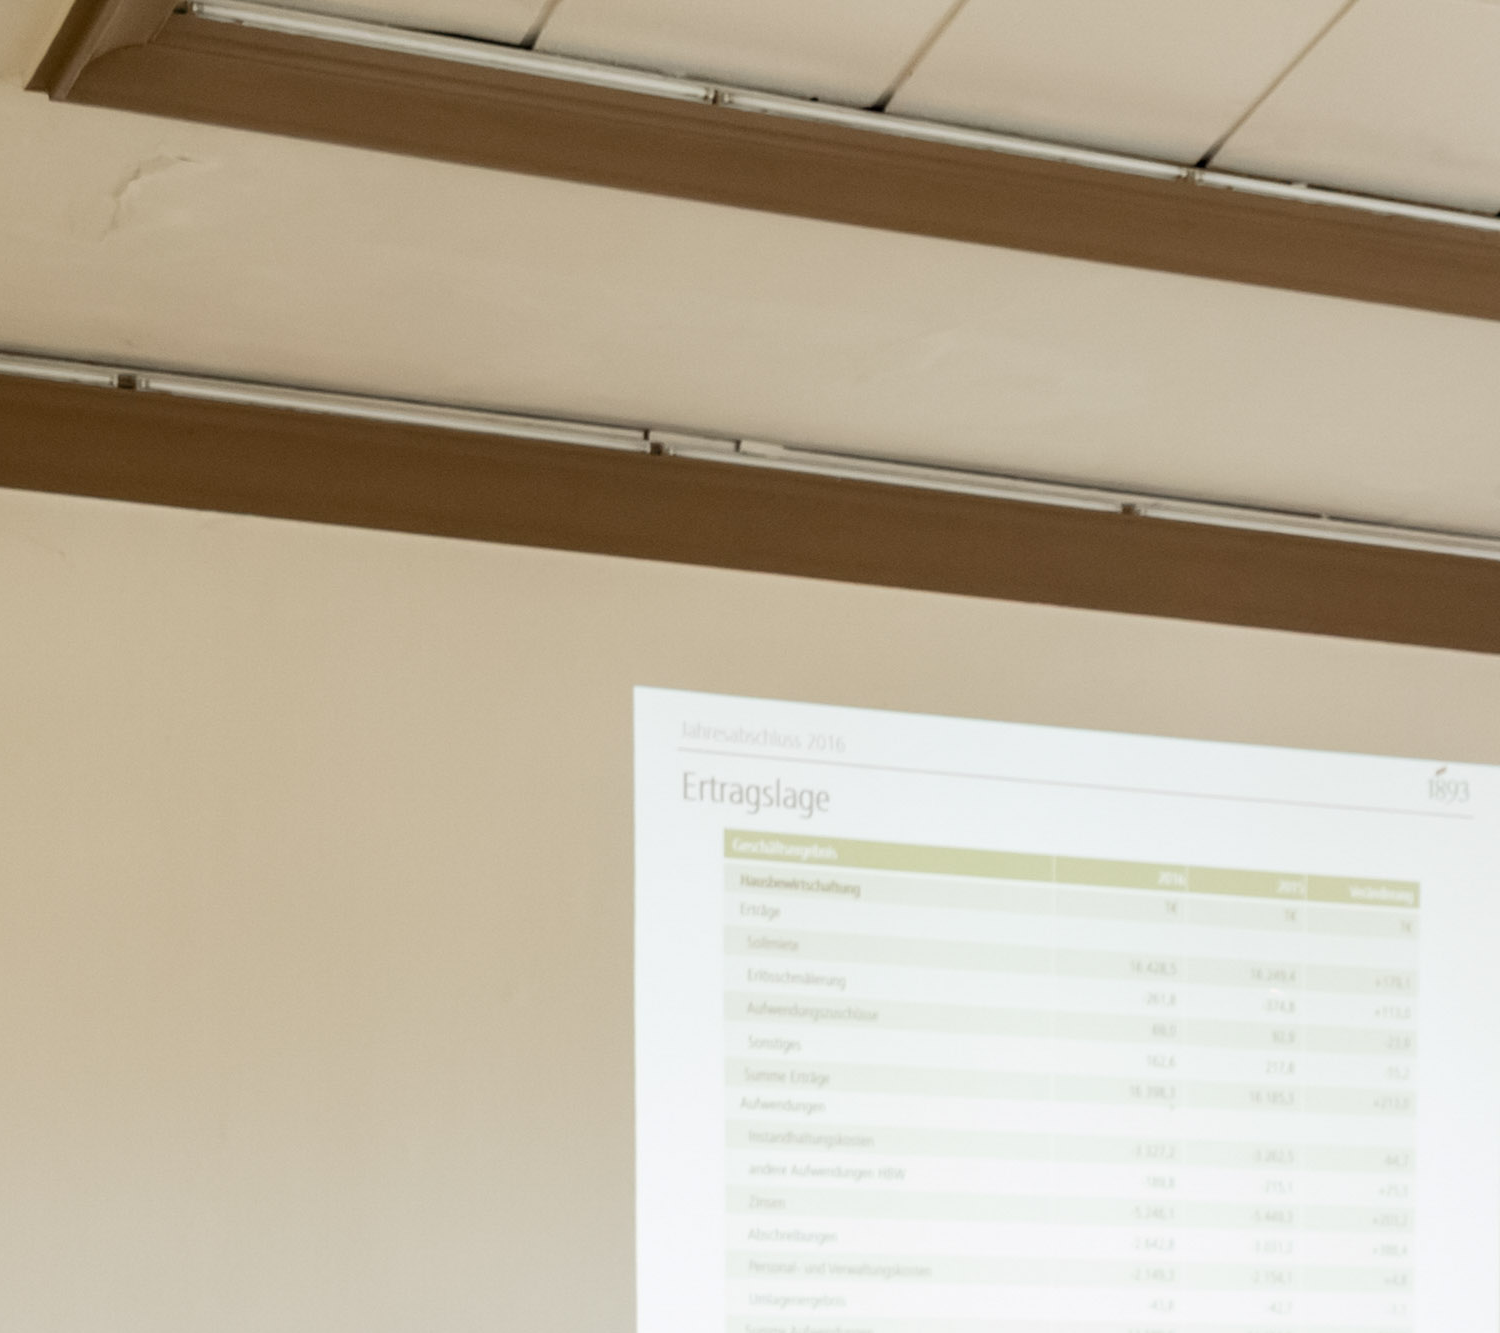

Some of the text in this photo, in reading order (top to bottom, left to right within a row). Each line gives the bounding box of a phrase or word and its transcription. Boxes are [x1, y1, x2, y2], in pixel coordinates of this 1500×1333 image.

[681, 720, 846, 753] Jahresabschluss 2016
[682, 771, 831, 819] Ertragslage
[1427, 776, 1471, 803] 1893
[739, 874, 861, 899] Hausbewirtschaftung
[739, 903, 781, 921] Erträge
[748, 1035, 802, 1054] Sonstiges
[739, 1097, 826, 1116] Aufwendungen
